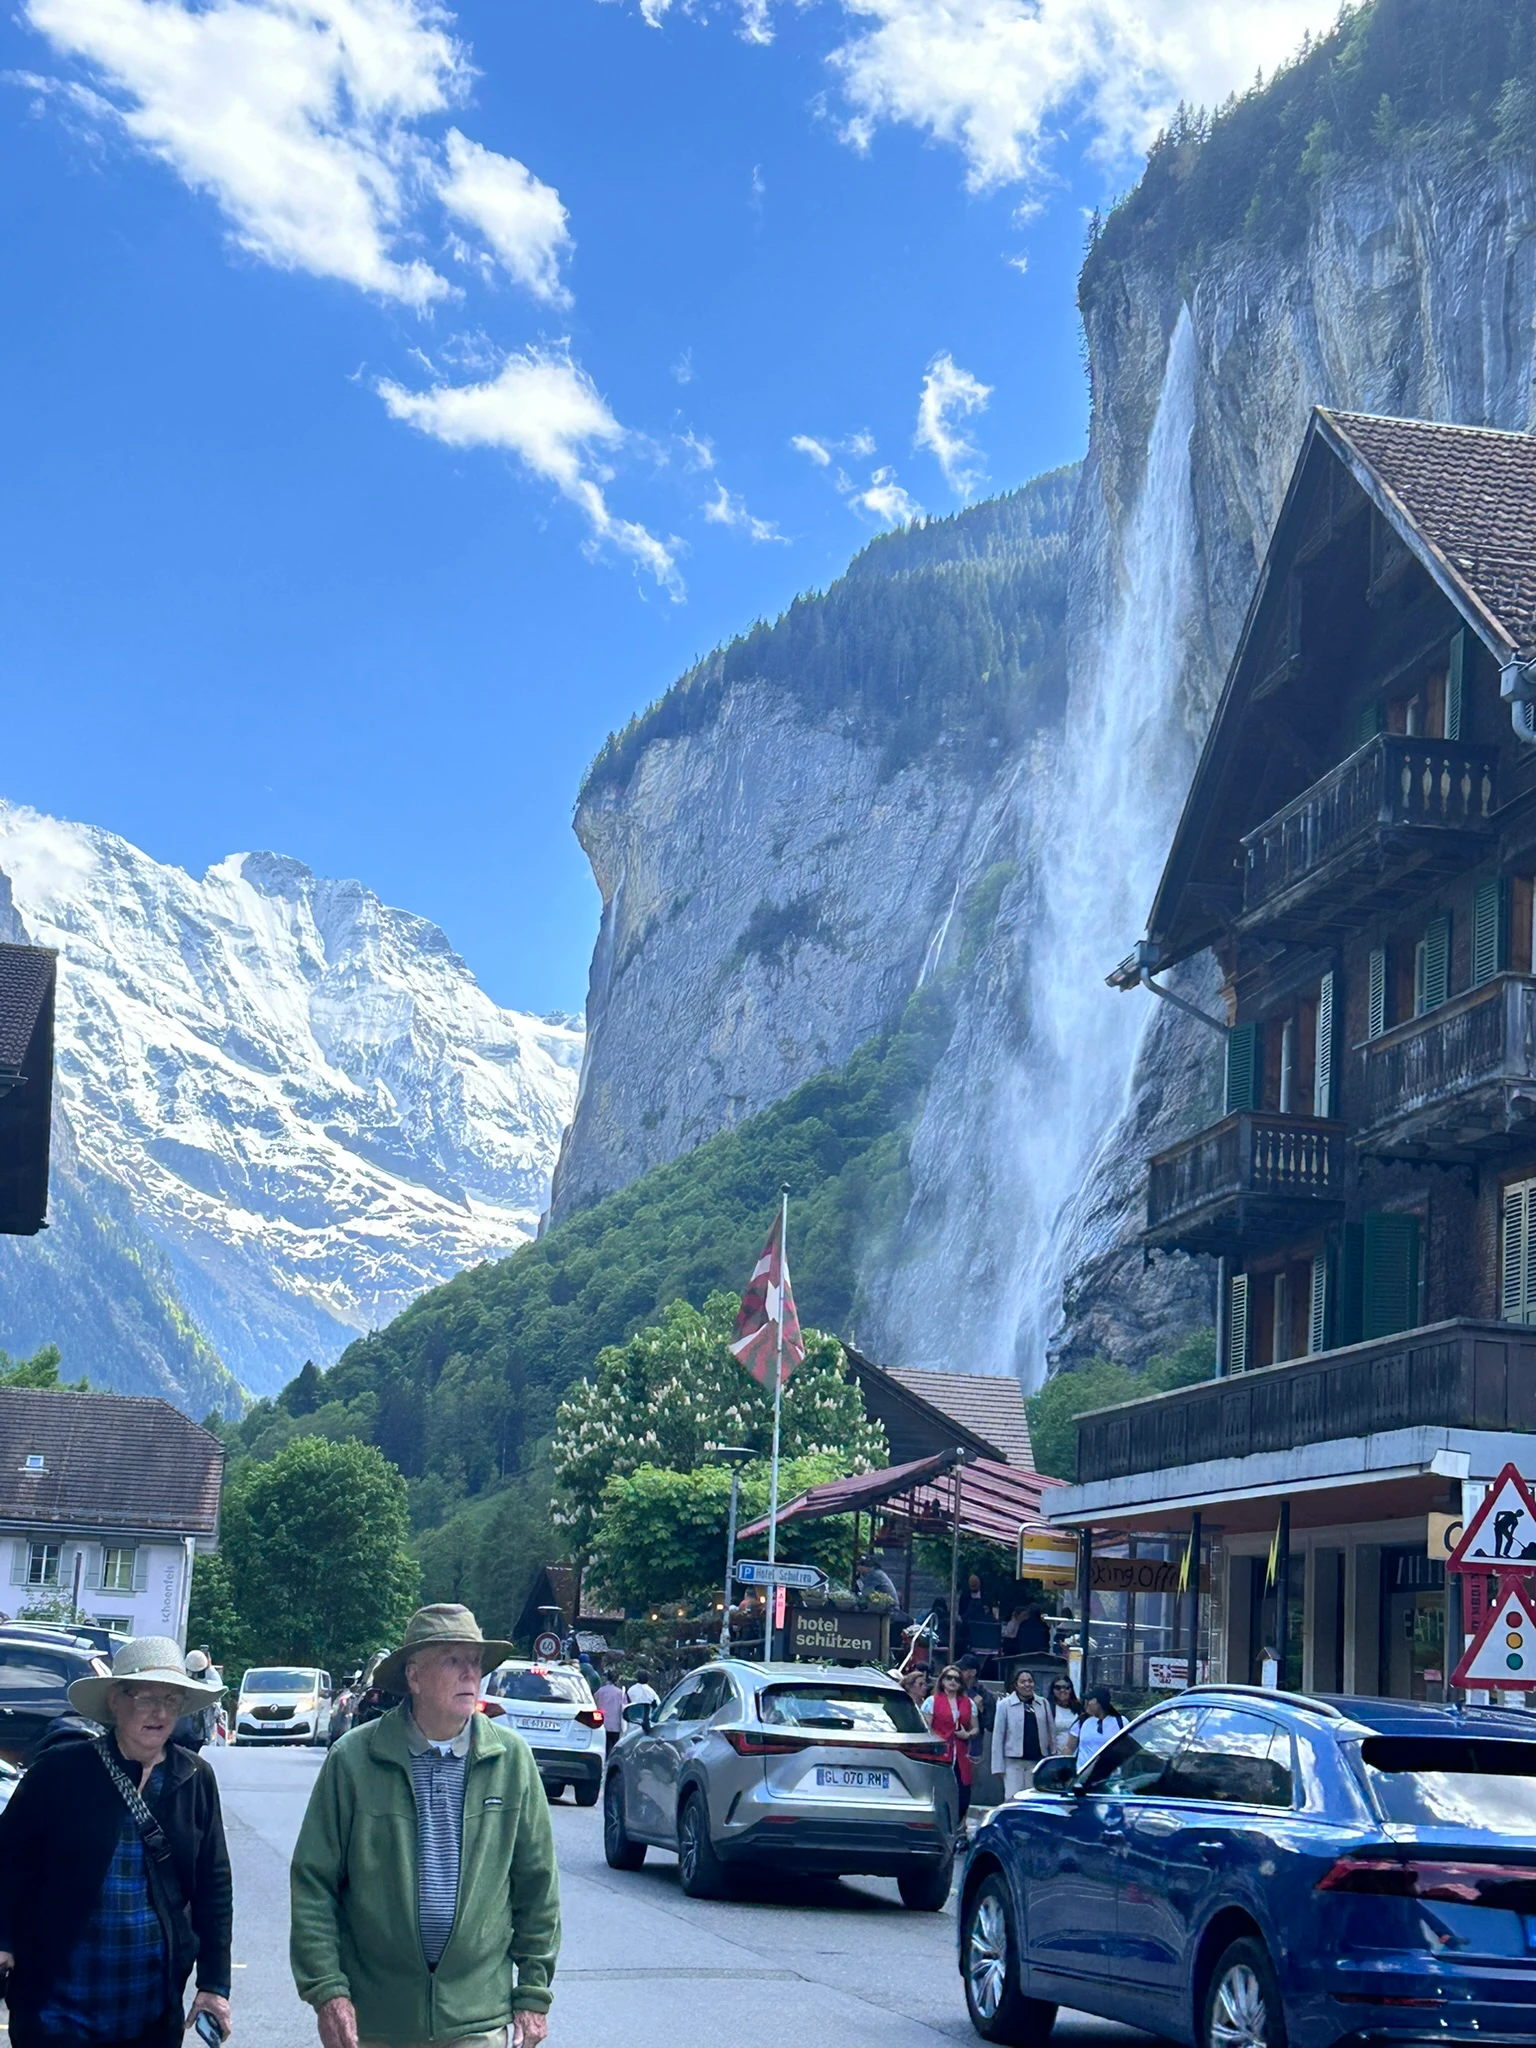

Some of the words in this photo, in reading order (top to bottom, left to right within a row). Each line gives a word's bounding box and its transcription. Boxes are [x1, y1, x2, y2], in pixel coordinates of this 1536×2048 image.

[161, 1565, 175, 1623] schoenfels
[797, 1615, 838, 1632] hotel
[796, 1632, 872, 1650] schützen
[825, 1770, 838, 1784] GL
[843, 1771, 863, 1786] 070
